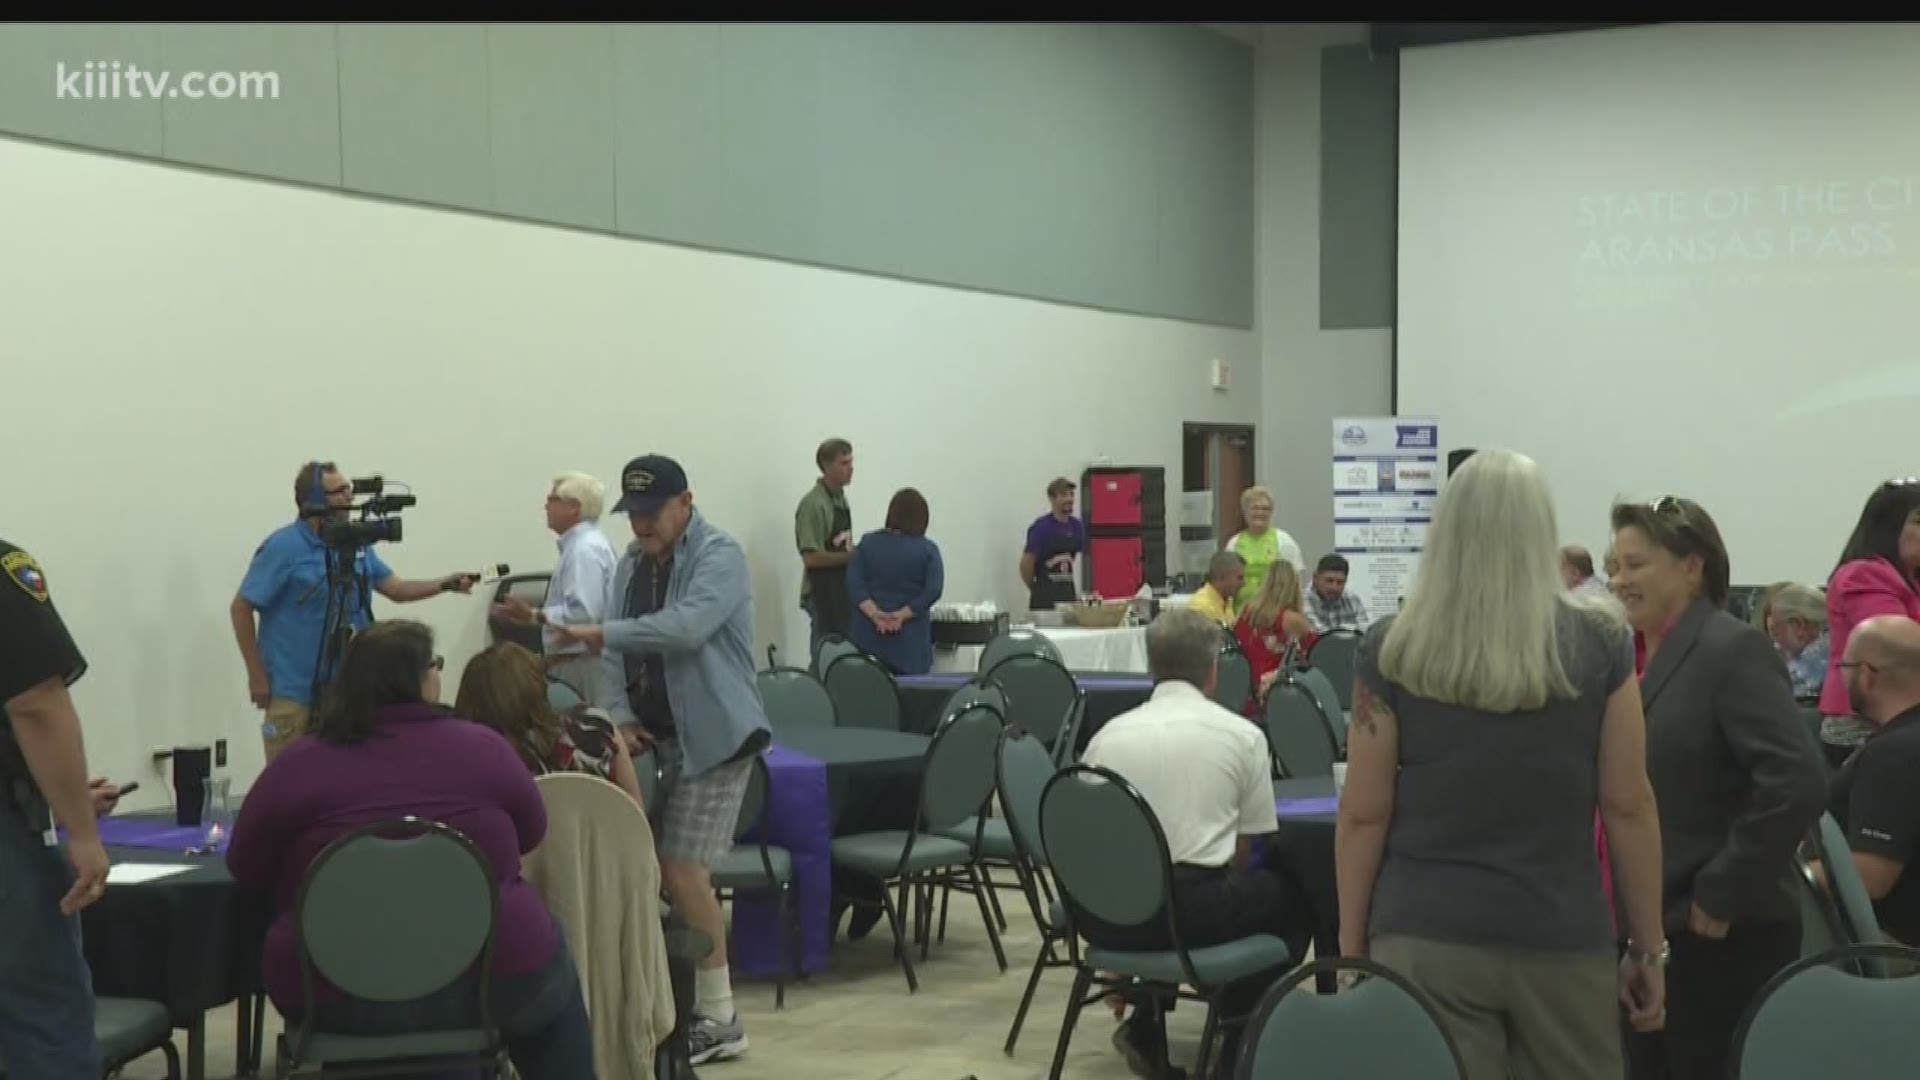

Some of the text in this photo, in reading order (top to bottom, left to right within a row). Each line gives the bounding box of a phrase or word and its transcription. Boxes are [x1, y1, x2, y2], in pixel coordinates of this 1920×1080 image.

[1576, 191, 1689, 228] STATE
[1703, 185, 1761, 220] OF
[1777, 180, 1849, 216] THE
[1578, 220, 1897, 266] ARANSAS PASS
